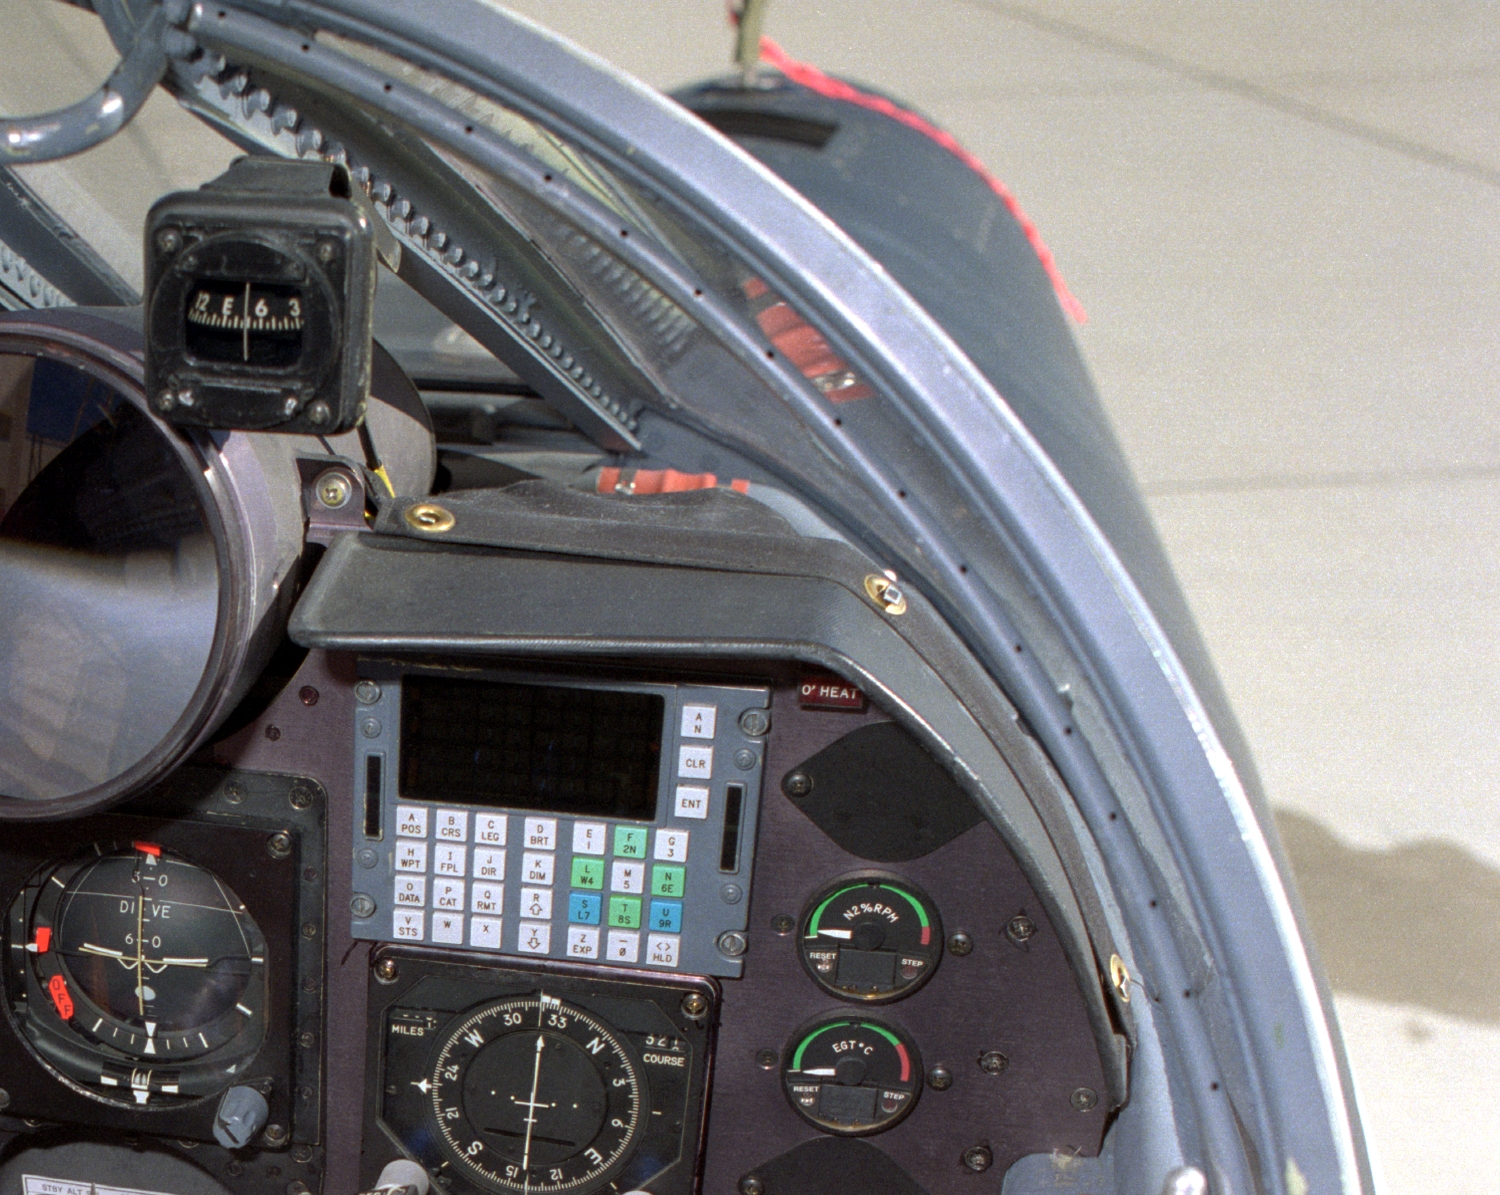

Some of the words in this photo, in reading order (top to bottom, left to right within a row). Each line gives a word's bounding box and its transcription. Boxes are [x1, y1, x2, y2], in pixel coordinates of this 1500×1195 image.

[222, 297, 234, 316] E
[255, 299, 268, 317] 6
[820, 685, 859, 699] HEAT
[686, 759, 706, 768] CLR
[681, 799, 701, 809] ENT
[402, 824, 421, 834] POS
[442, 828, 460, 837] CRS
[482, 832, 499, 841] LEG
[401, 860, 420, 868] WPT
[440, 863, 458, 872] FPL
[482, 867, 496, 876] DIR
[400, 894, 420, 902] DATA
[478, 902, 496, 910] RMT
[399, 927, 417, 936] STS
[572, 945, 592, 954] EXP
[653, 953, 672, 963] HLD
[810, 952, 836, 960] RESET
[902, 958, 923, 967] STEP
[392, 1025, 424, 1036] MILES
[643, 1054, 684, 1066] COURSE
[793, 1085, 819, 1093] RESET
[883, 1091, 905, 1101] STEP
[42, 1184, 63, 1193] STBY
[67, 1187, 82, 1195] ALT
